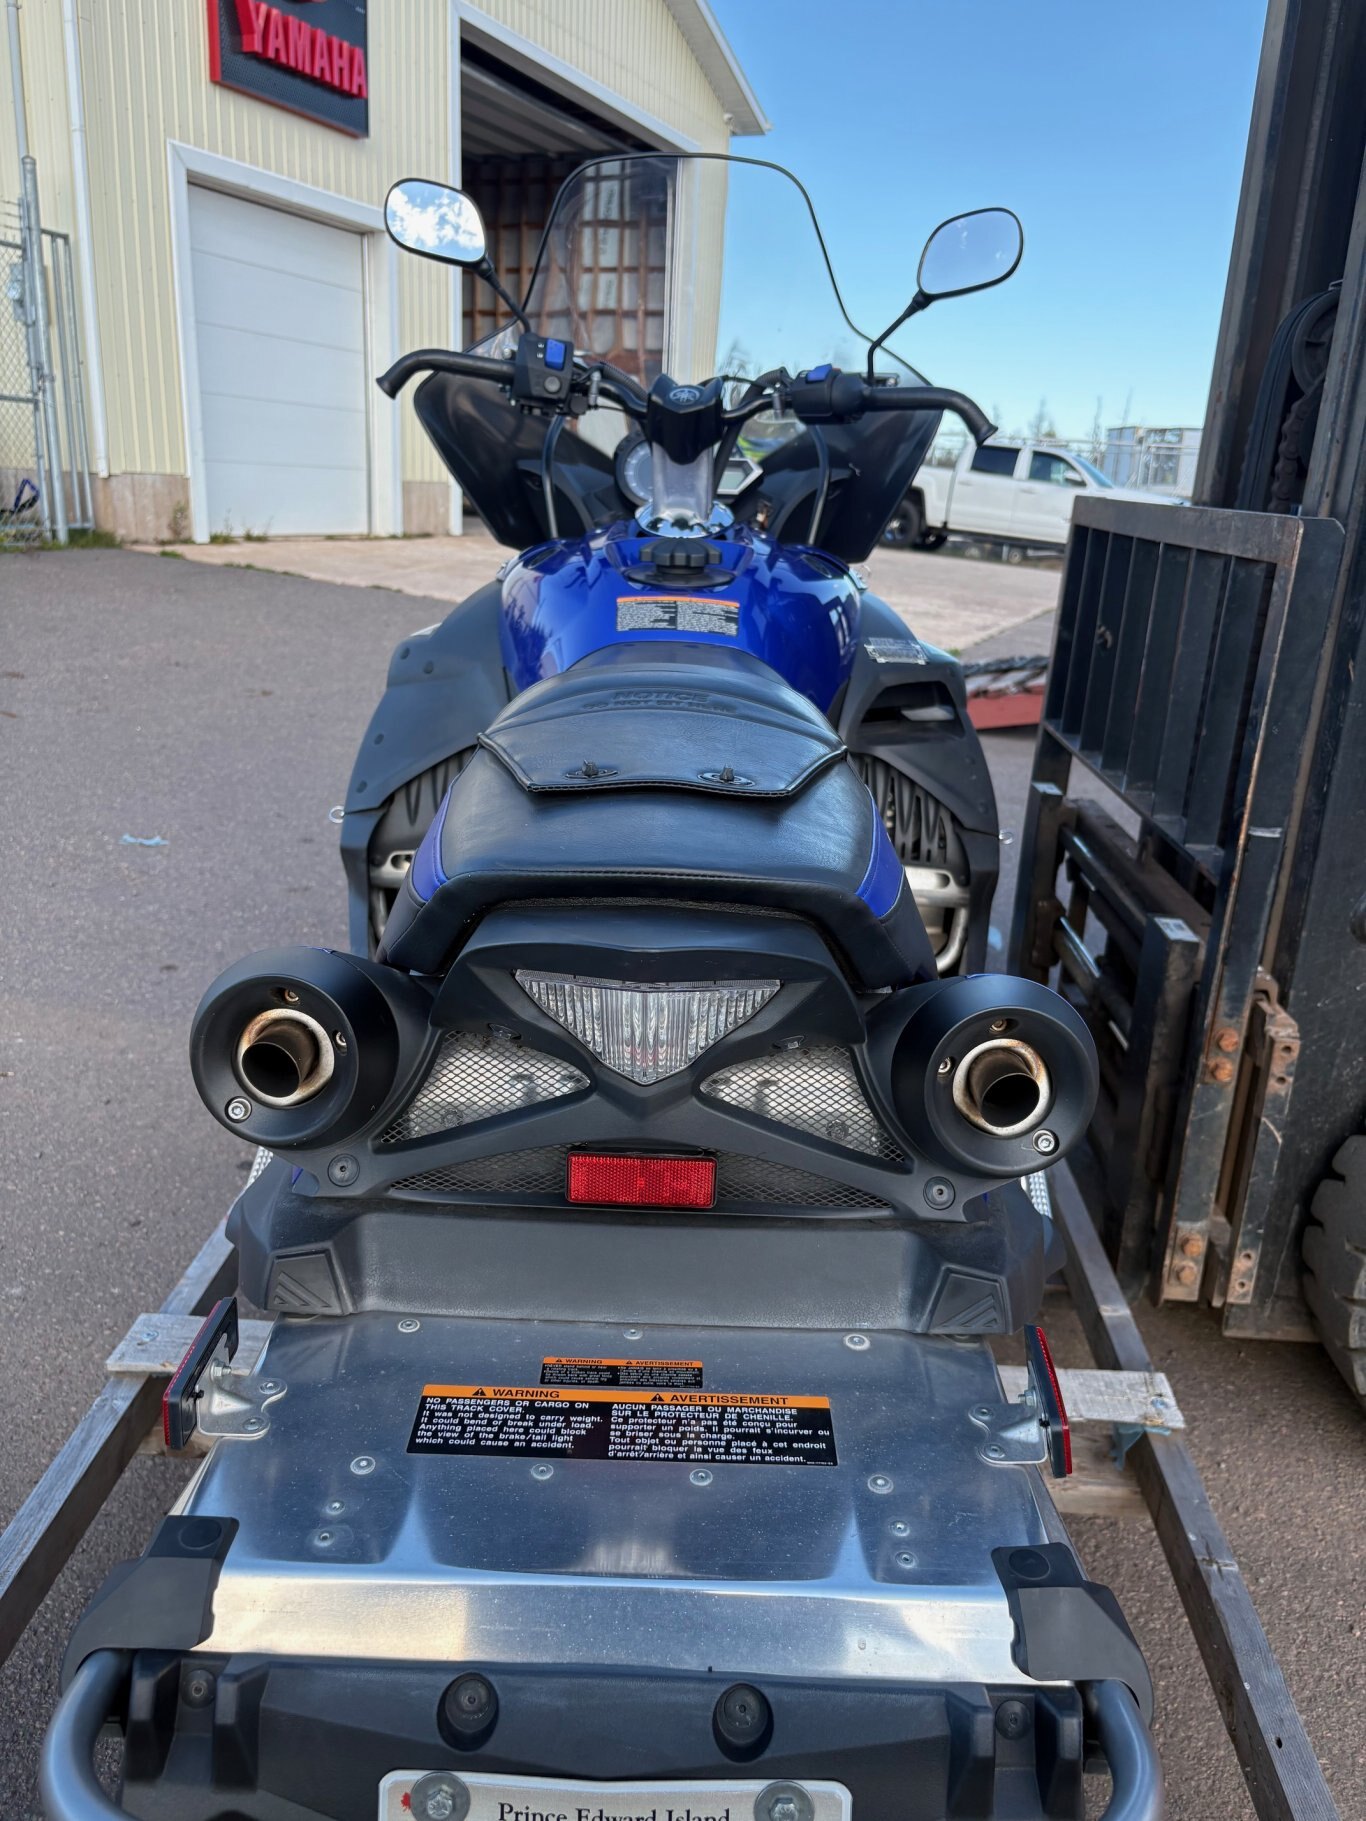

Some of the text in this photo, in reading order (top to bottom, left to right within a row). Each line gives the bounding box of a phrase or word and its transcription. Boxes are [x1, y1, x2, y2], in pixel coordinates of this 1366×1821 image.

[242, 0, 368, 99] YAMAHA
[492, 1388, 560, 1398] WARNING
[446, 1398, 510, 1406] PASSENGERS
[670, 1394, 788, 1405] AVERTISSEMENT
[425, 1403, 525, 1413] THIS TRACK COVER.
[612, 1403, 646, 1411] AUCUN
[651, 1404, 702, 1412] PASSAGER
[727, 1406, 797, 1415] MARCHANDISE
[478, 1412, 521, 1420] designed
[570, 1415, 603, 1423] weight.
[611, 1409, 632, 1417] SUR
[654, 1411, 719, 1419] PROTECTEUR
[743, 1413, 793, 1421] CHENILLE.
[507, 1419, 534, 1427] break
[539, 1420, 566, 1428] under
[571, 1421, 594, 1429] load.
[628, 1417, 677, 1425] protecteur
[419, 1423, 462, 1432] Anything
[466, 1425, 498, 1433] placed
[610, 1423, 656, 1431] supporter
[679, 1425, 707, 1433] poids.
[723, 1426, 761, 1434] pourrait
[766, 1427, 813, 1435] s'incurver
[417, 1429, 433, 1437] the
[438, 1430, 459, 1438] view
[499, 1432, 547, 1441] brake/tail
[552, 1434, 573, 1442] light
[700, 1432, 735, 1441] charge.
[531, 1440, 574, 1449] accident.
[609, 1436, 630, 1444] Tout
[635, 1437, 659, 1445] objet
[682, 1438, 726, 1447] personne
[731, 1440, 757, 1448] placé
[792, 1441, 826, 1449] endroit
[608, 1443, 648, 1452] pourrait
[652, 1444, 689, 1453] bloquer
[730, 1446, 747, 1454] des
[689, 1452, 712, 1460] ainsi
[765, 1454, 806, 1462] accident.
[498, 1802, 567, 1821] Prince
